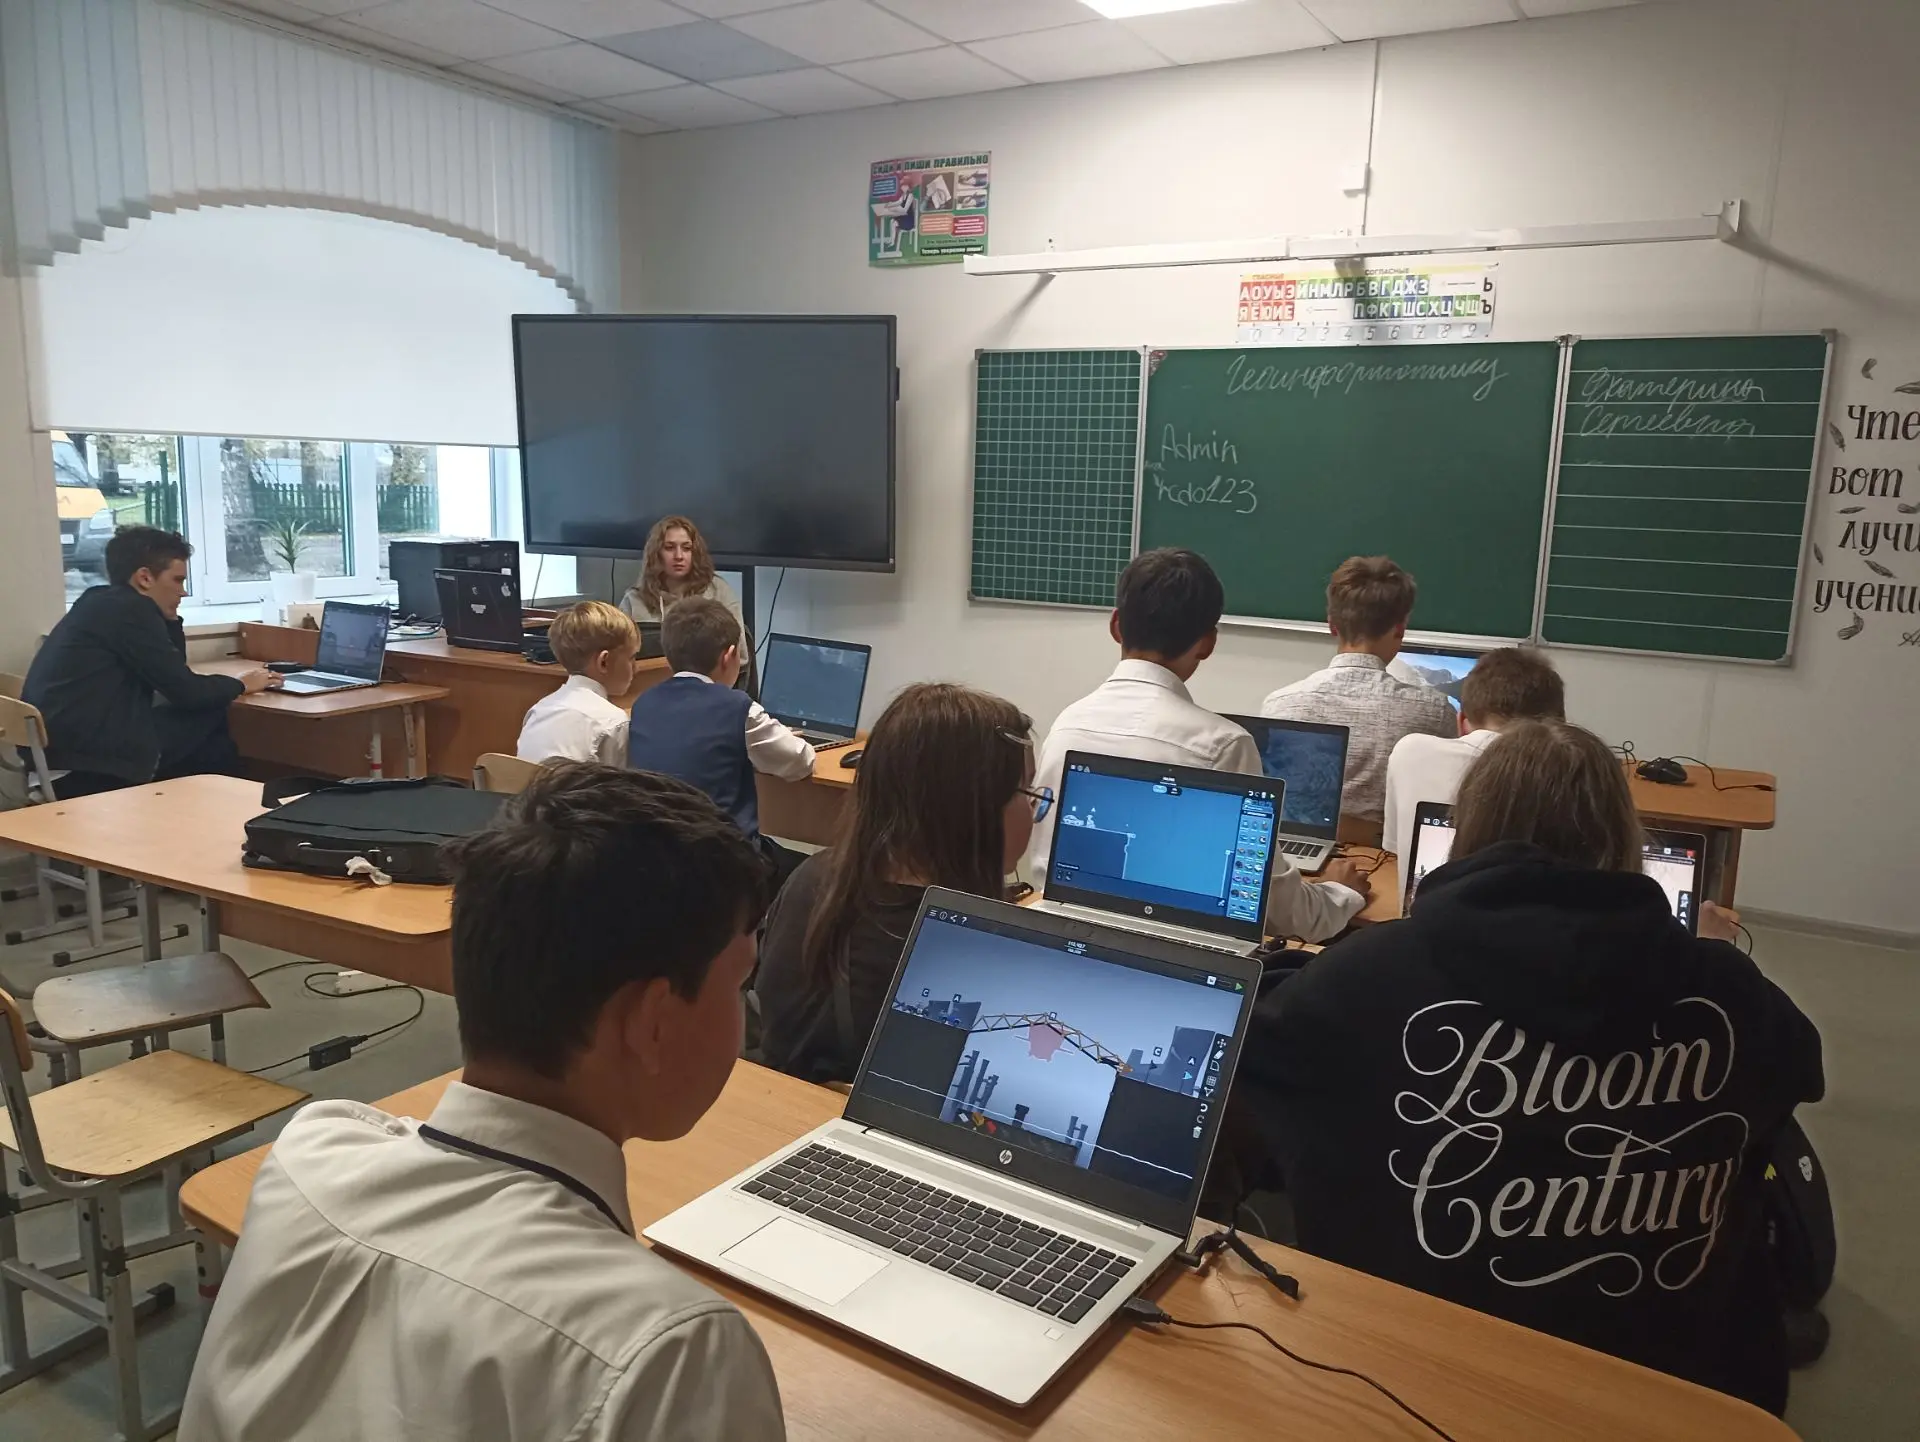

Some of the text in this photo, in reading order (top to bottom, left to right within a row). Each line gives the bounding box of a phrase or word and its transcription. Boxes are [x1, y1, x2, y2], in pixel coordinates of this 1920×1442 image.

[904, 160, 930, 170] ПИШИ
[934, 154, 988, 168] ПРАВИЛЬНО
[1365, 268, 1409, 276] СОГЛАСНЫЕ
[1161, 423, 1238, 464] Admin
[1828, 466, 1904, 498] вот
[1396, 1000, 1733, 1122] Bloom
[1389, 1118, 1736, 1290] Century
